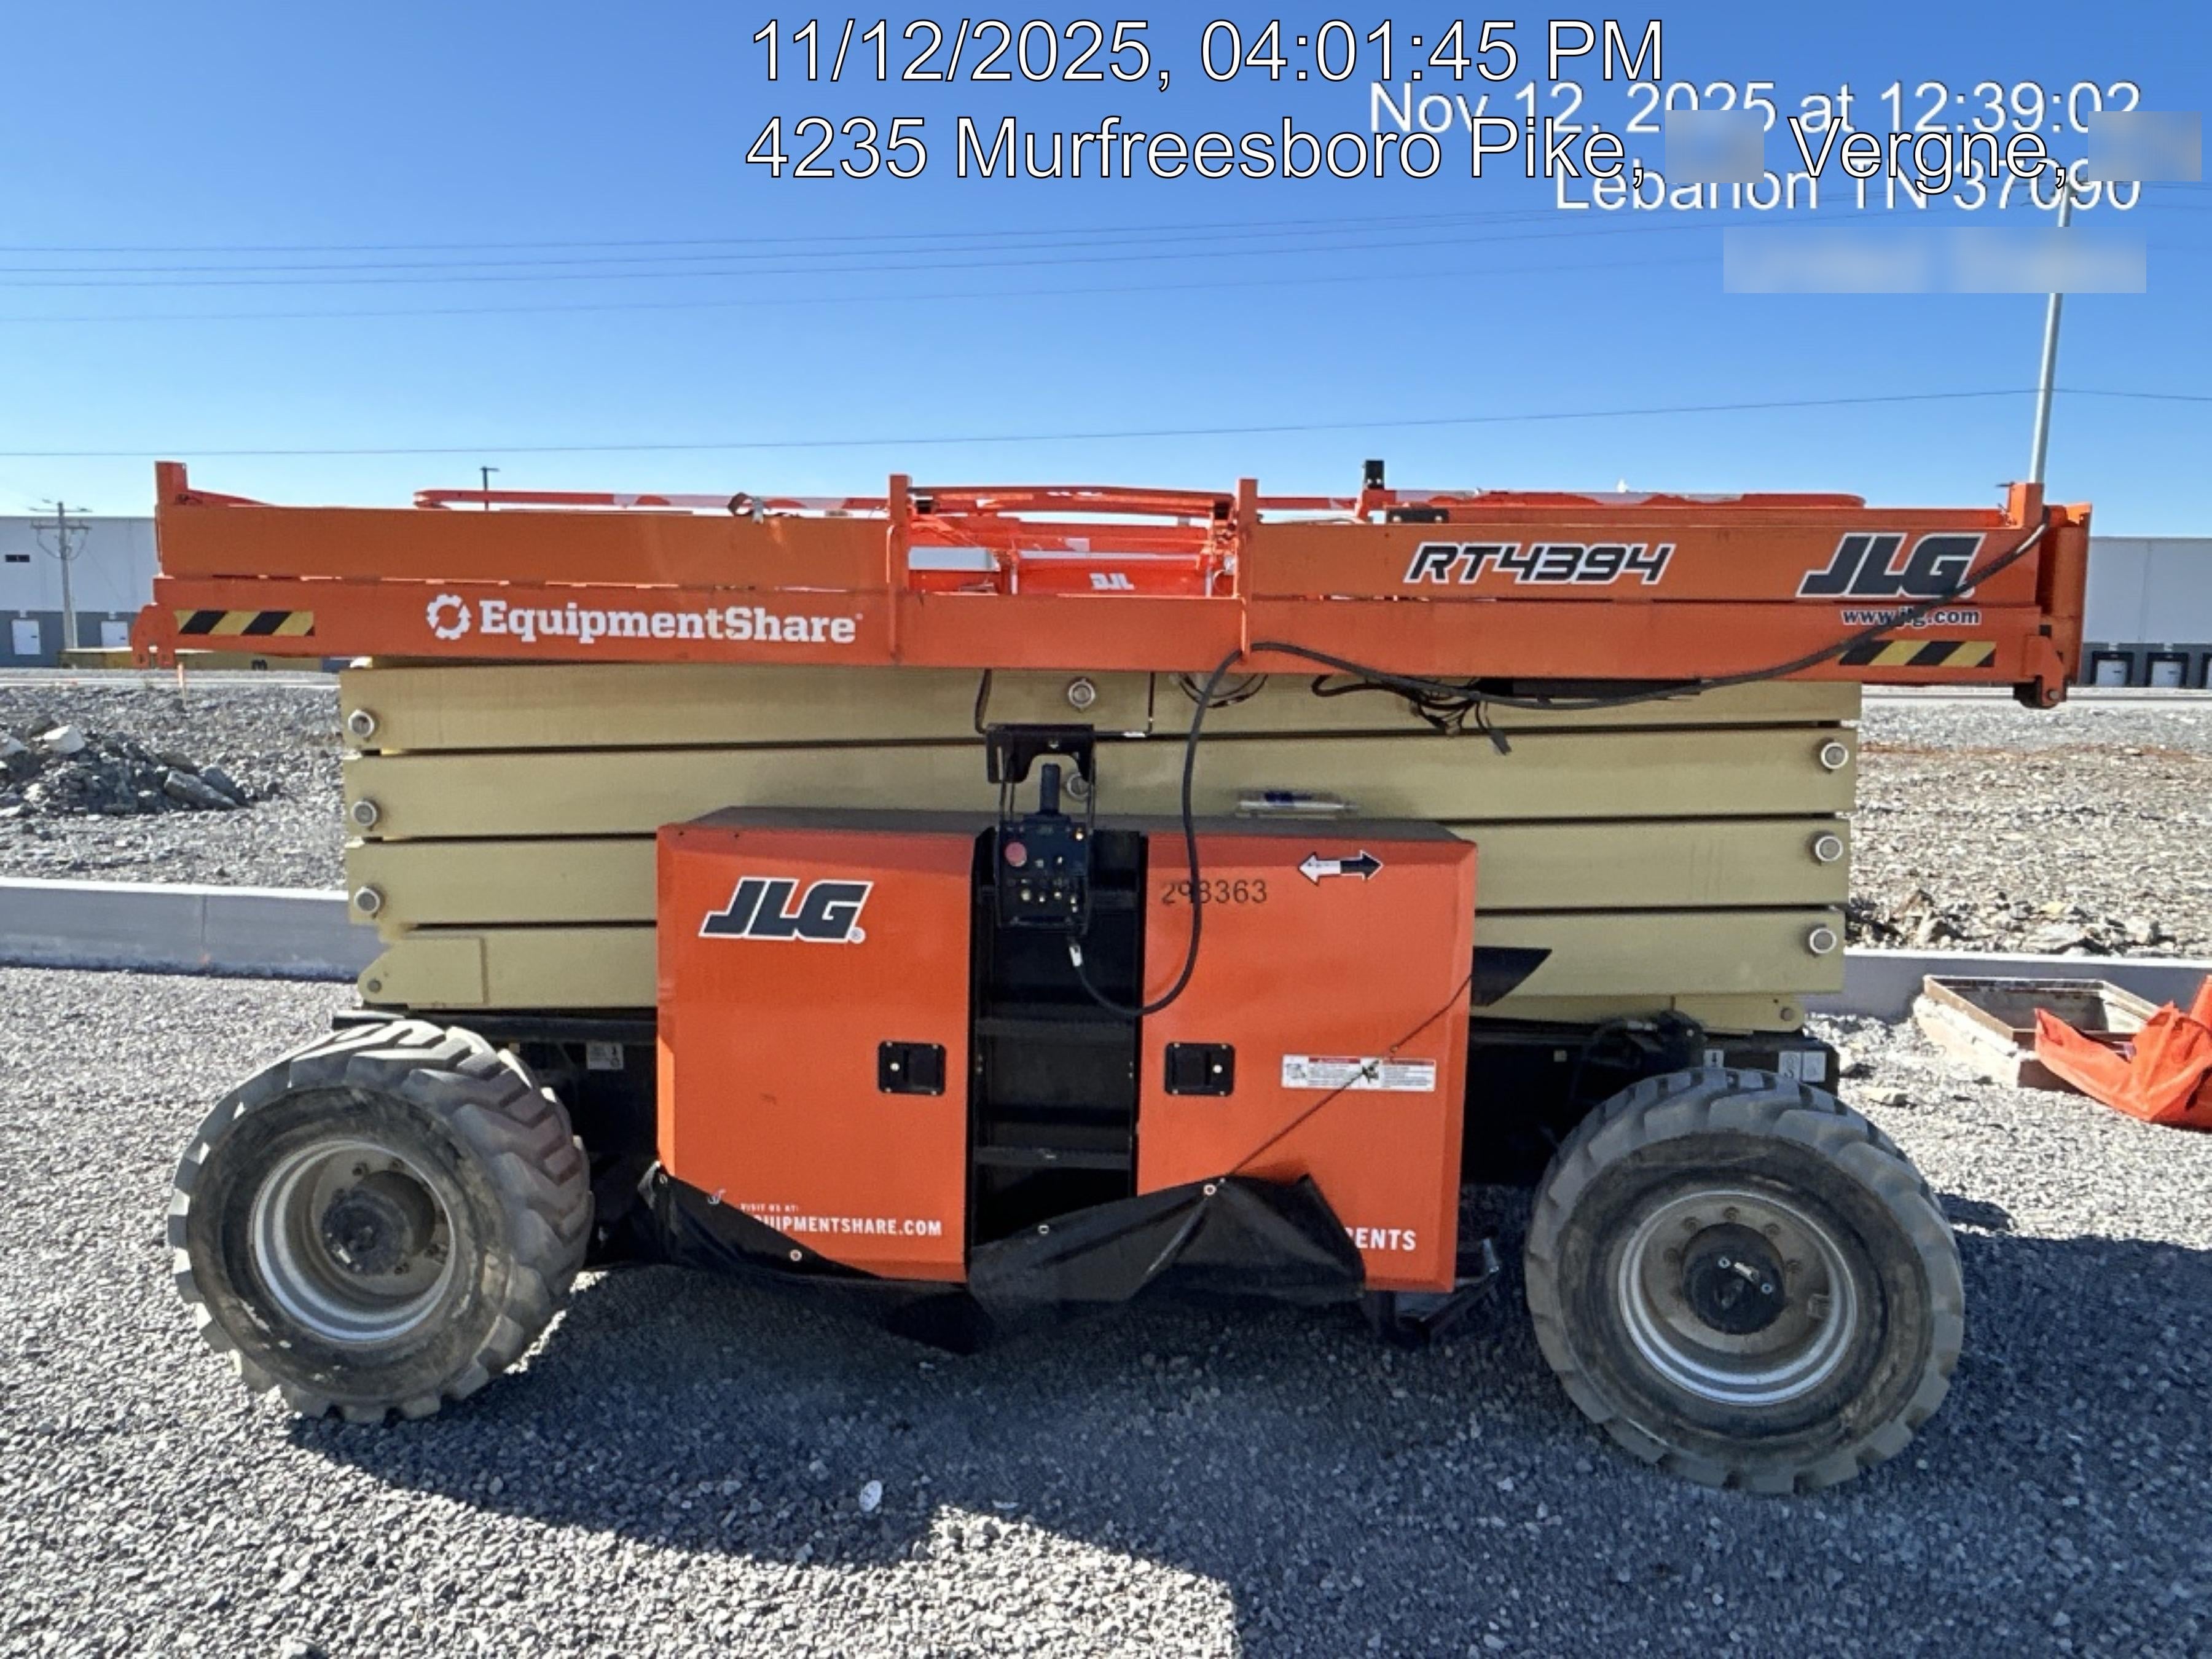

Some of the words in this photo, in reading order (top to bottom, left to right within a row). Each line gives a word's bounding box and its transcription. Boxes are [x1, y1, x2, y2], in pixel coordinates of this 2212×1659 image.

[1403, 542, 1676, 585] RT4394
[1795, 533, 1987, 598] JLG
[480, 600, 856, 643] EquipmentShare
[698, 876, 874, 943] JLG
